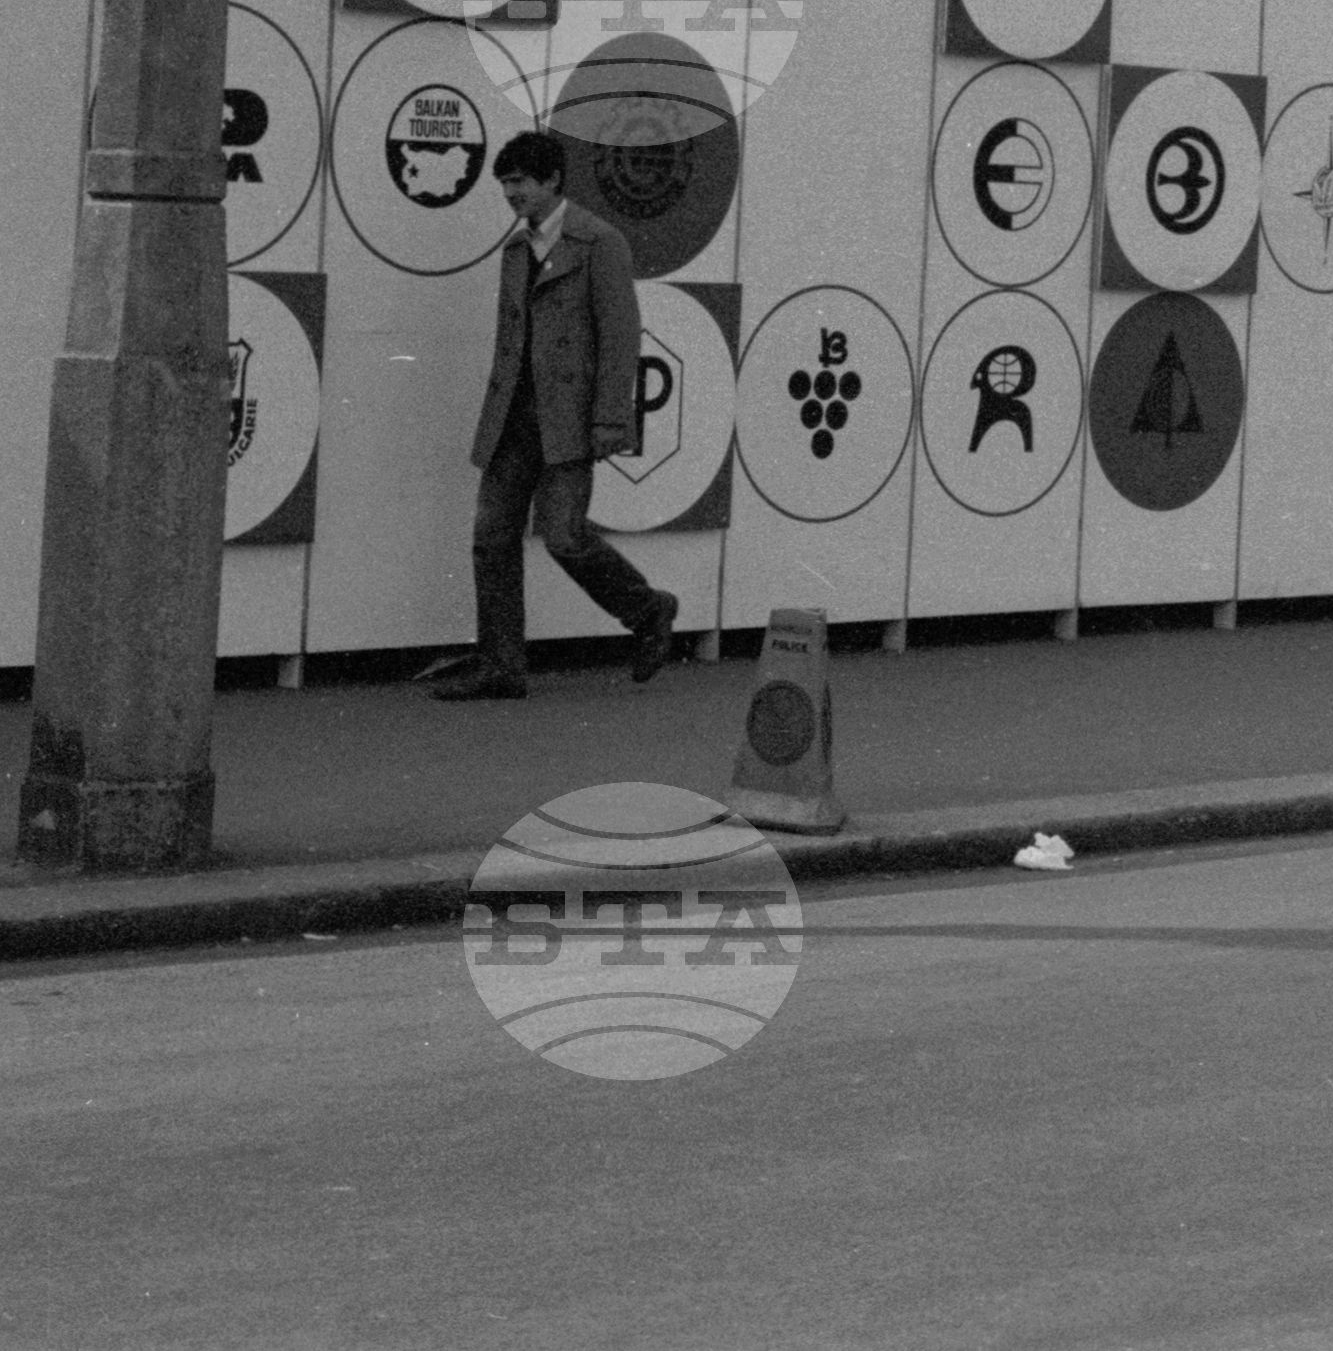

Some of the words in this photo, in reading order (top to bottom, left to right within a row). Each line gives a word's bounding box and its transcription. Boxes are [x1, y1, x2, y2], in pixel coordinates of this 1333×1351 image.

[415, 98, 460, 118] BALKAN
[409, 117, 463, 139] TOURISTE
[771, 638, 809, 654] POLICE
